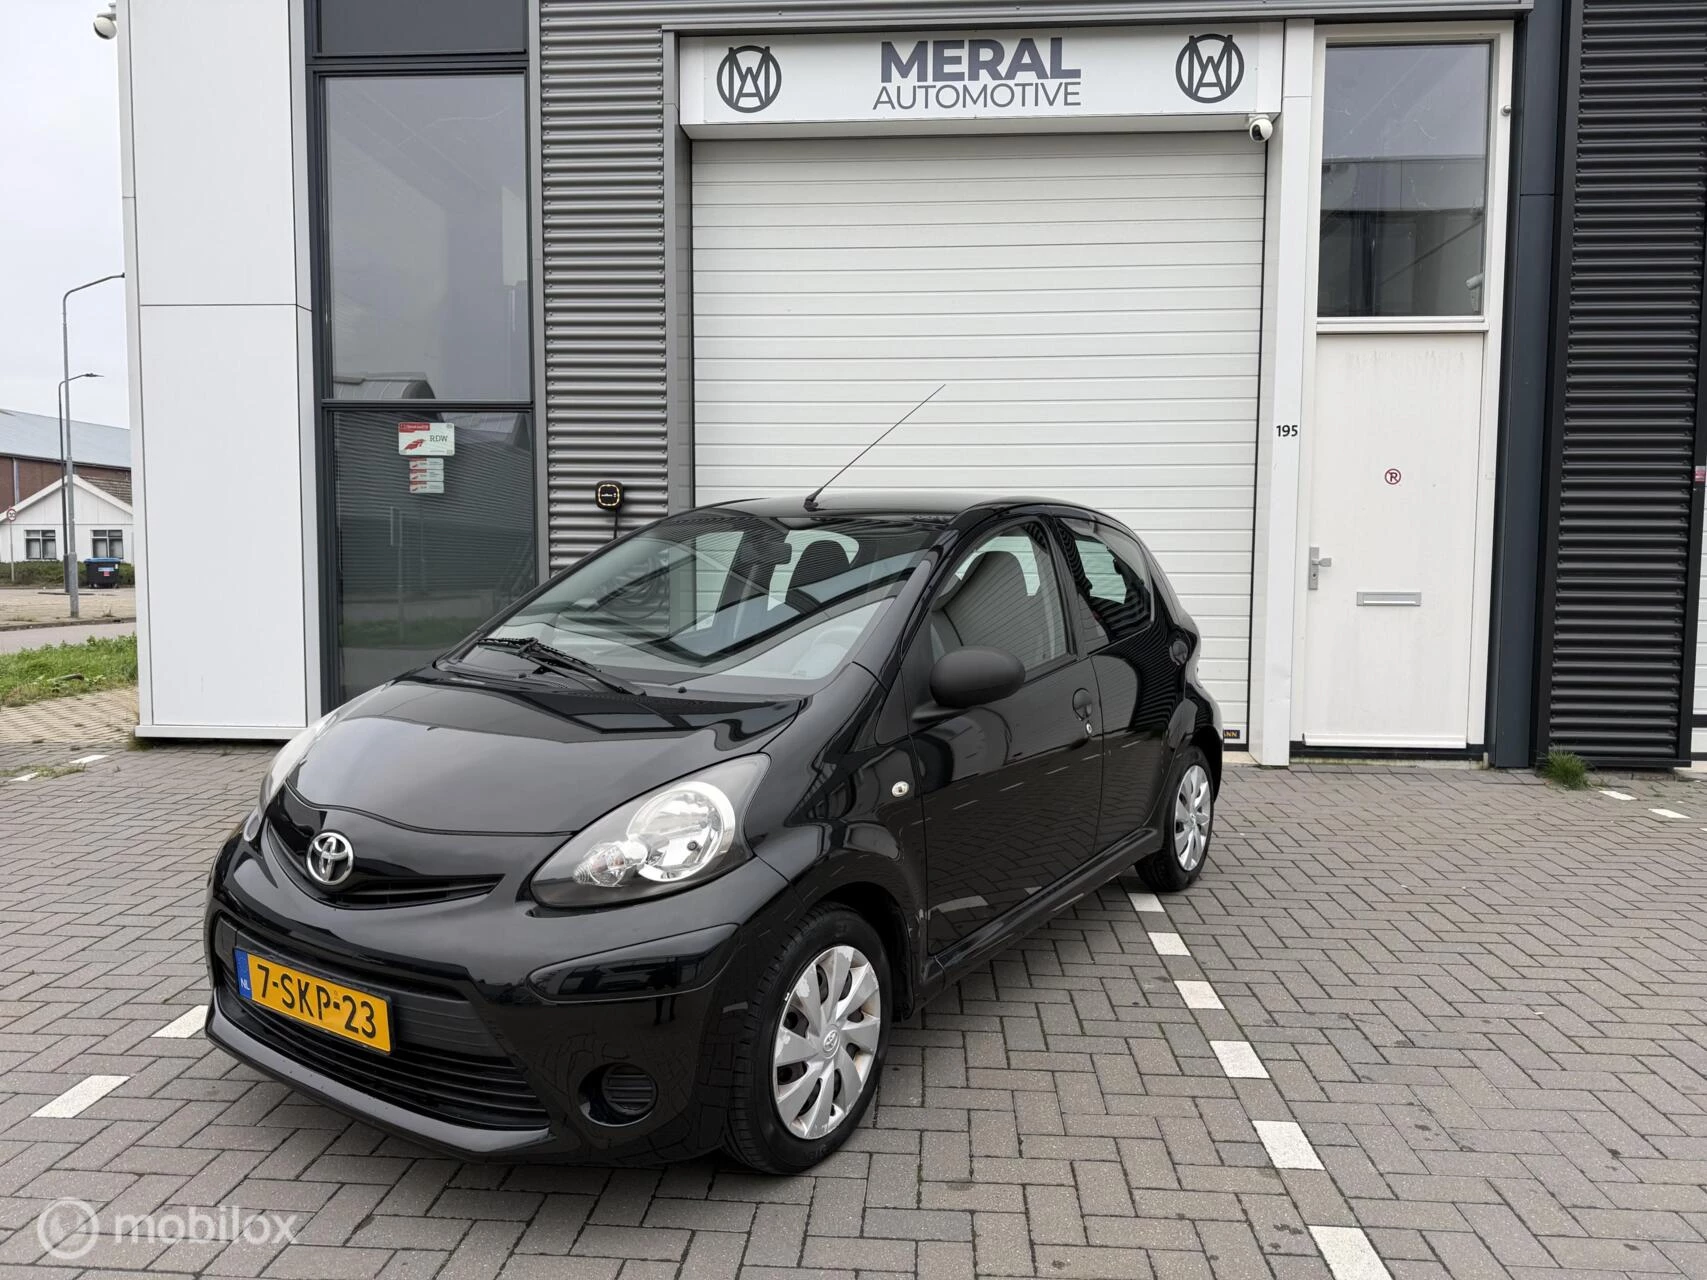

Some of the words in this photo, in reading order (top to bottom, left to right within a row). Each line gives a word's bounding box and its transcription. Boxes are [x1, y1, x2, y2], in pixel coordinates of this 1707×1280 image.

[880, 37, 1082, 83] MERAL
[872, 81, 1082, 110] AUTOMOTIVE
[429, 434, 448, 442] RDW
[1276, 424, 1298, 437] 195
[240, 977, 250, 990] NL
[257, 963, 377, 1039] 7-SKP-23
